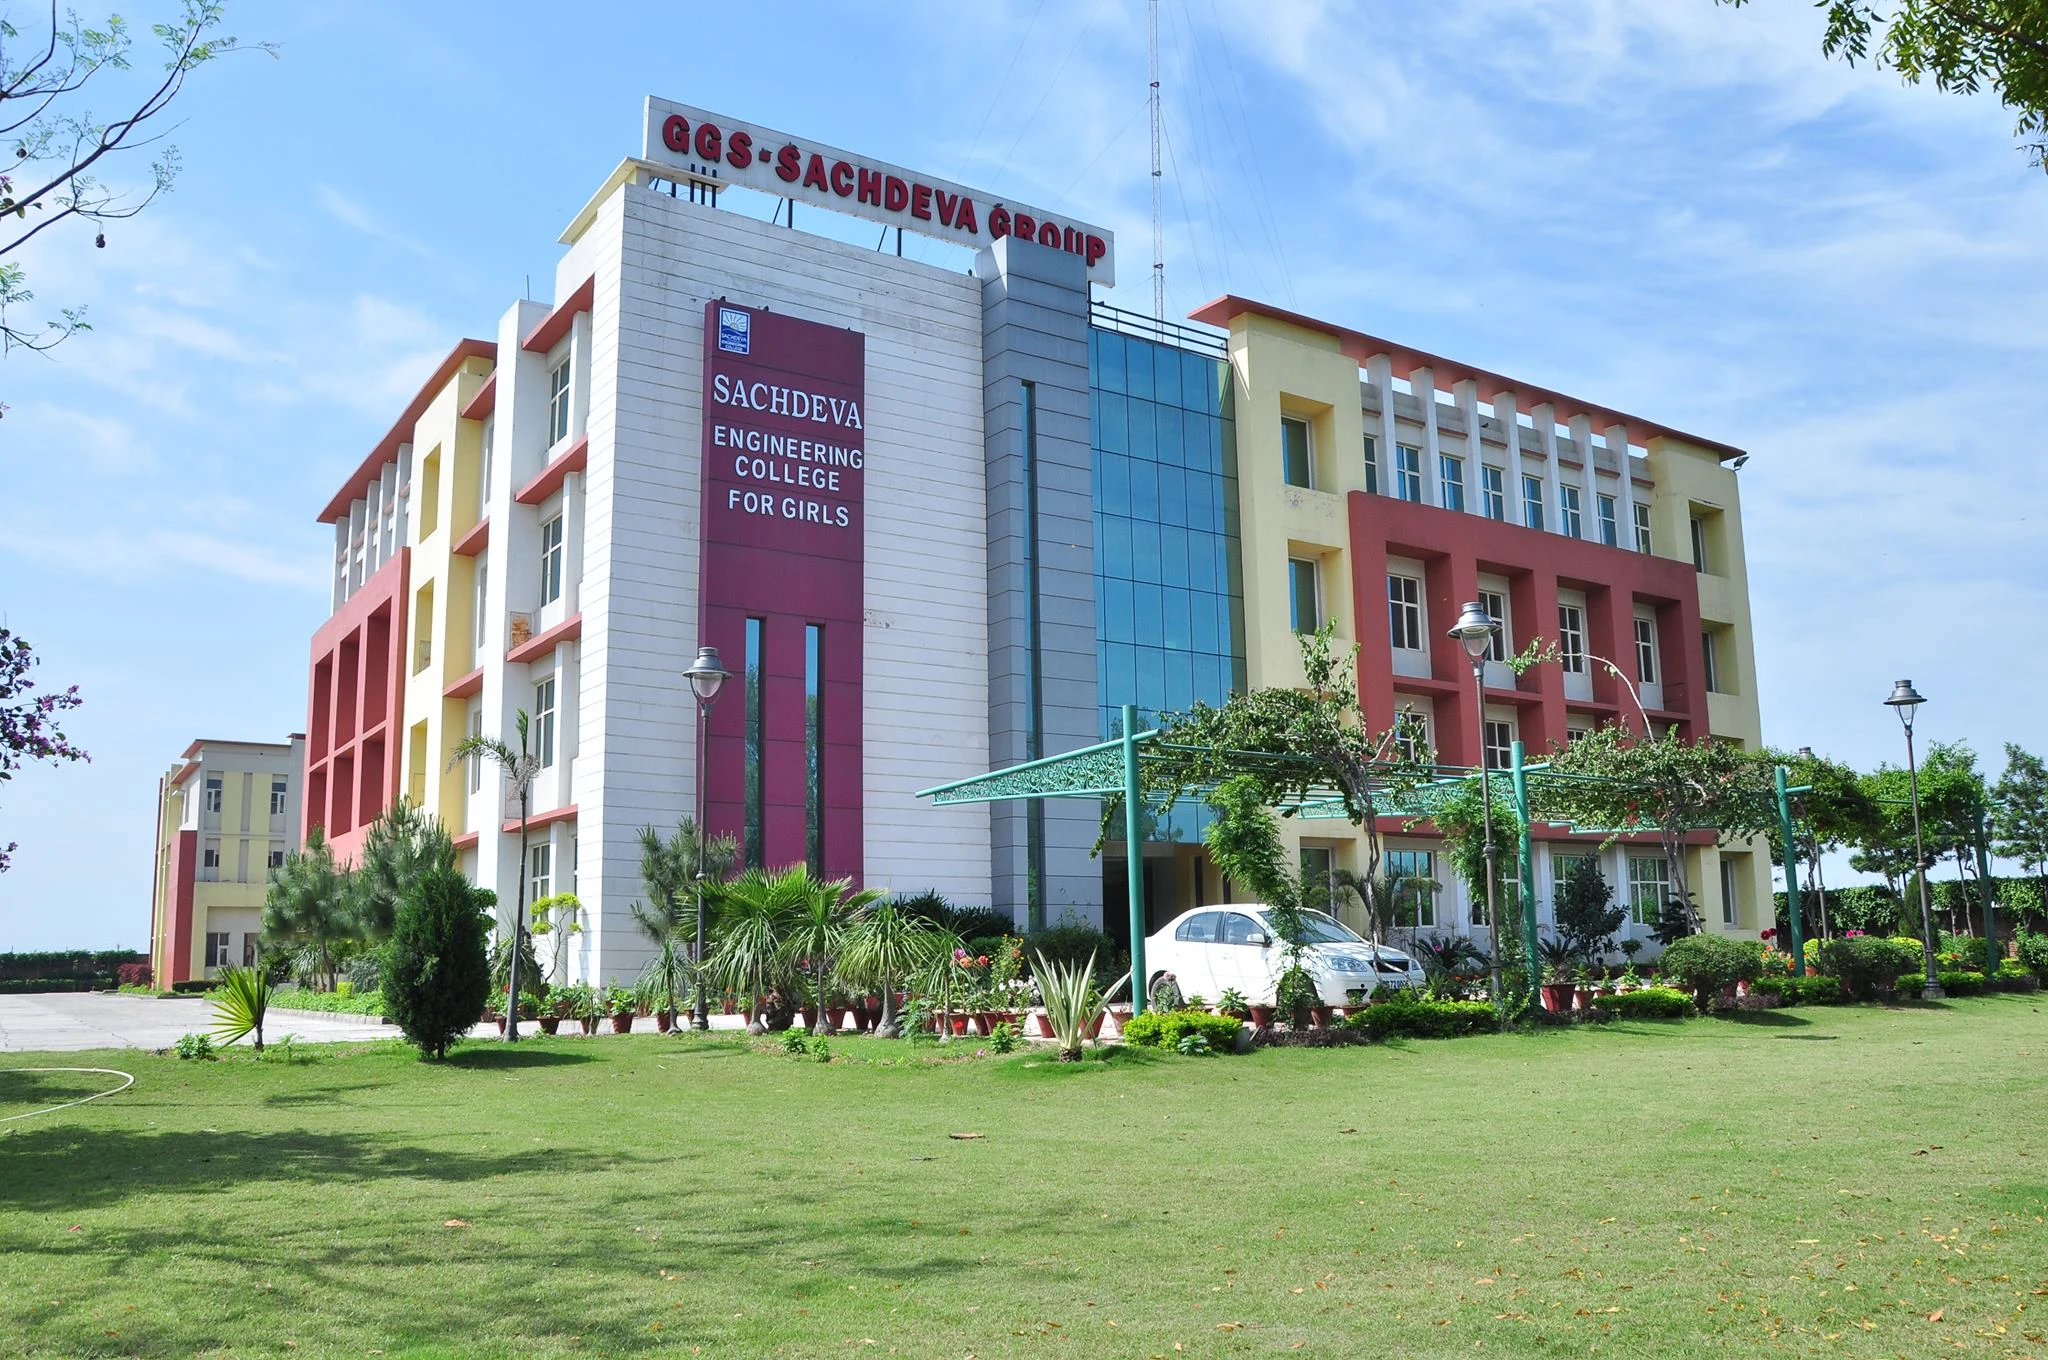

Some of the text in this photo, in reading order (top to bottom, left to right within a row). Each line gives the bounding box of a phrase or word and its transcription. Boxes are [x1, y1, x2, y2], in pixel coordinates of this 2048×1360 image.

[989, 207, 1106, 267] GROUP
[713, 374, 863, 429] SACHDEVA
[714, 425, 863, 469] ENGINEERING
[735, 455, 840, 491] COLLEGE
[729, 489, 849, 527] FOR GIRLS
